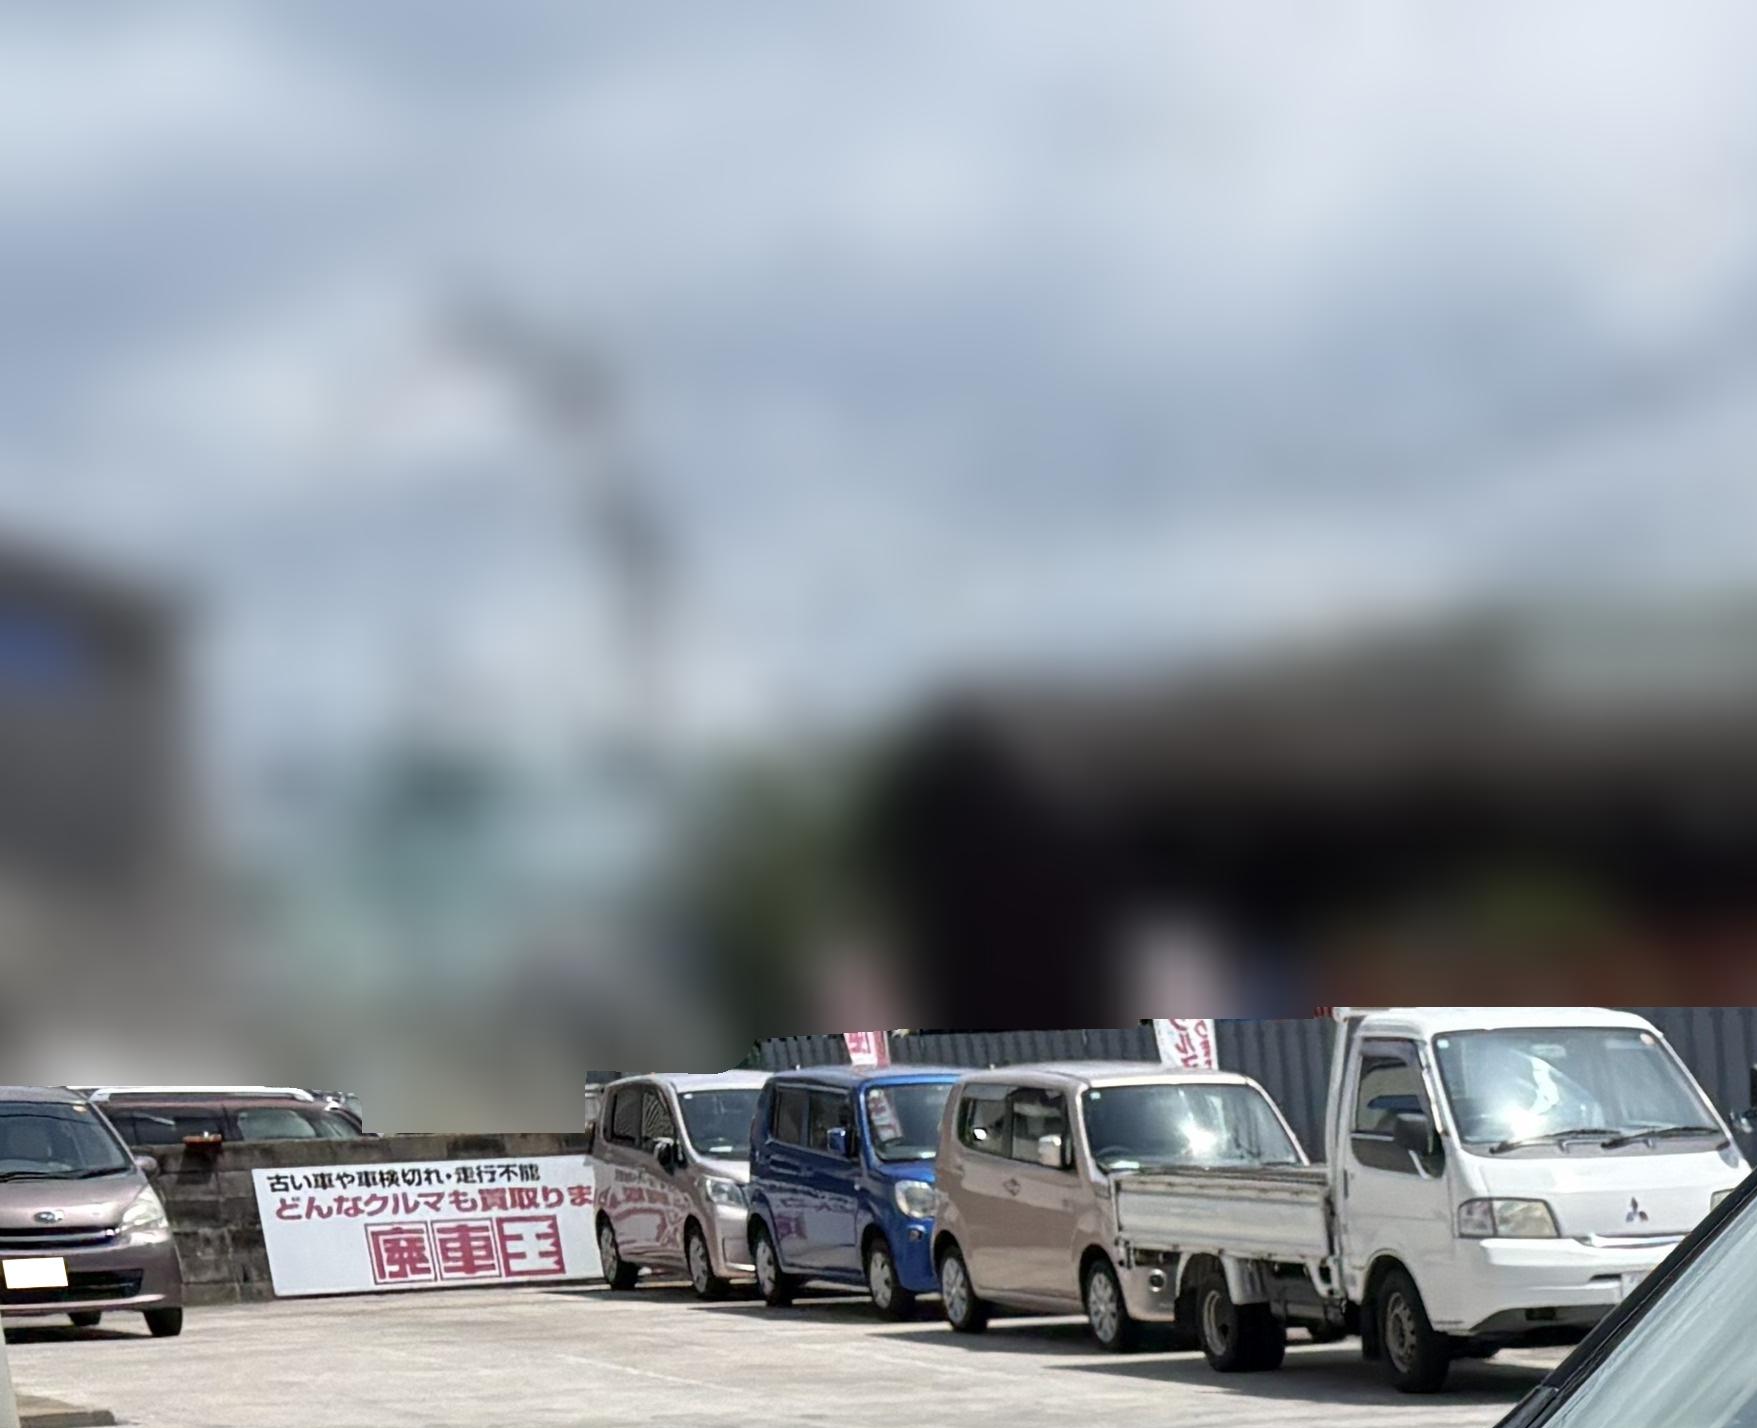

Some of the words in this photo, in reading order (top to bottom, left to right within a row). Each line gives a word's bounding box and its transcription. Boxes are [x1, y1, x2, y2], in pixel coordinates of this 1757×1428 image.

[267, 1163, 541, 1193] 古い車や車検切れ・走行不能
[275, 1184, 594, 1220] どんなクルマも買取りま
[366, 1214, 566, 1284] 廃車王
